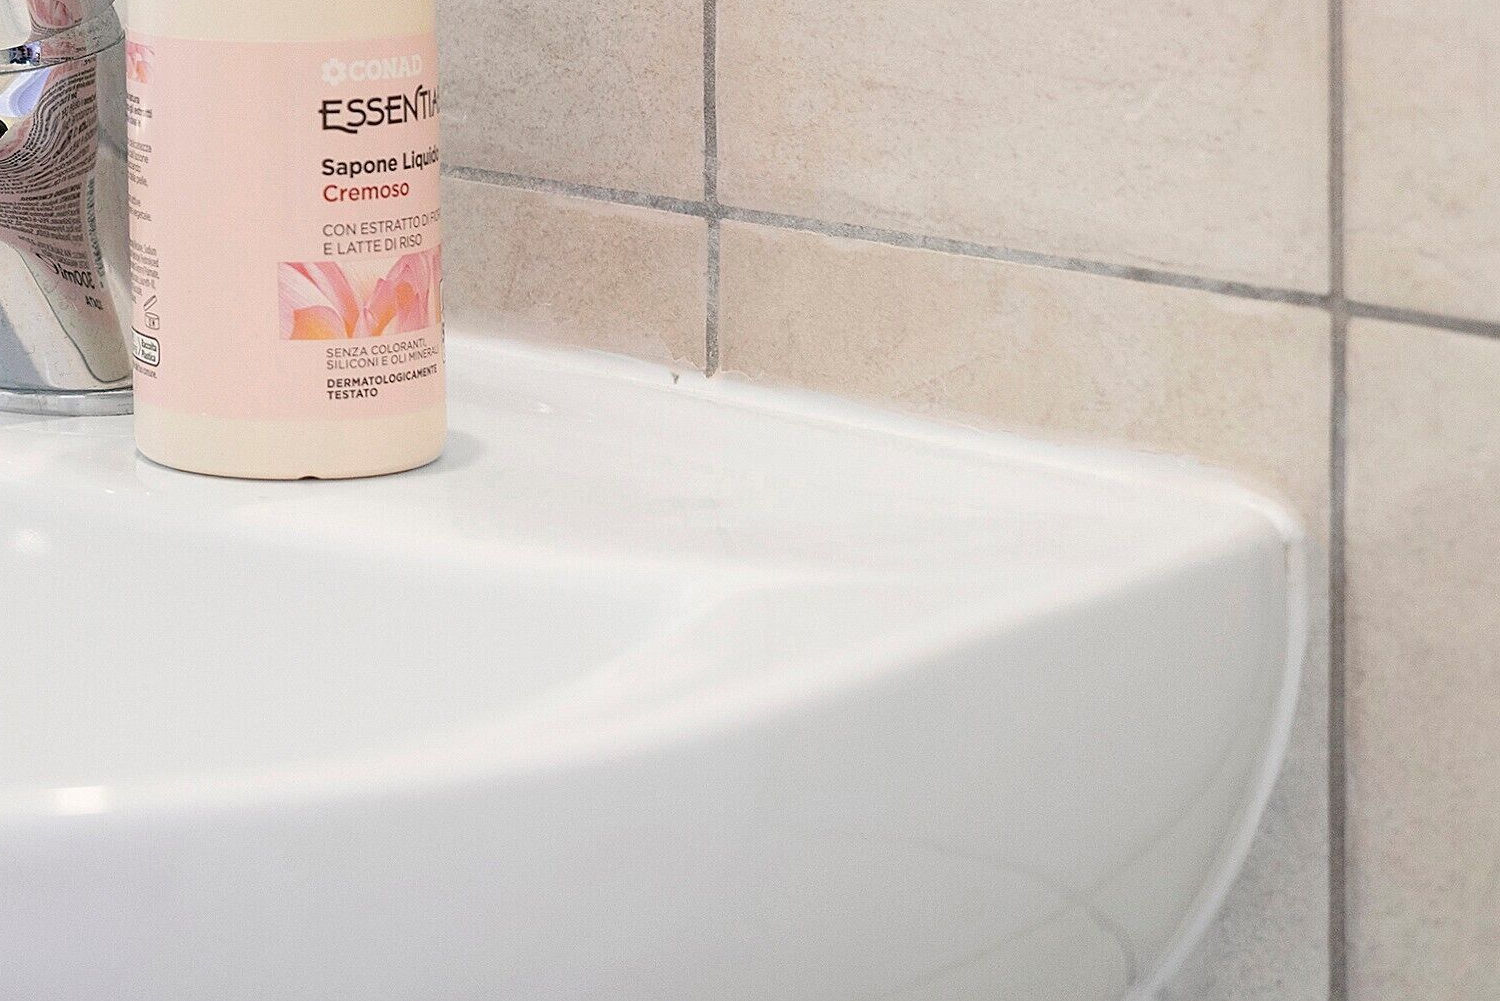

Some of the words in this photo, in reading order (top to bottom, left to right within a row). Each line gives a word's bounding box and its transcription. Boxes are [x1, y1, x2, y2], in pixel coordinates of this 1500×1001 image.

[349, 53, 423, 81] CONAD
[321, 157, 398, 178] Sapone
[322, 182, 410, 203] Cremoso
[322, 222, 357, 237] CON
[360, 215, 421, 235] ESTRATTO
[323, 242, 333, 256] E
[336, 239, 382, 255] LATTE
[384, 237, 397, 251] DI
[400, 233, 423, 249] RISO
[326, 346, 369, 358] SENZA
[326, 357, 379, 371] SILICONI
[381, 356, 389, 366] E
[390, 353, 407, 365] OLI
[326, 363, 438, 389] DERMATOLOGICAMENTE
[326, 387, 379, 401] TESTATO
